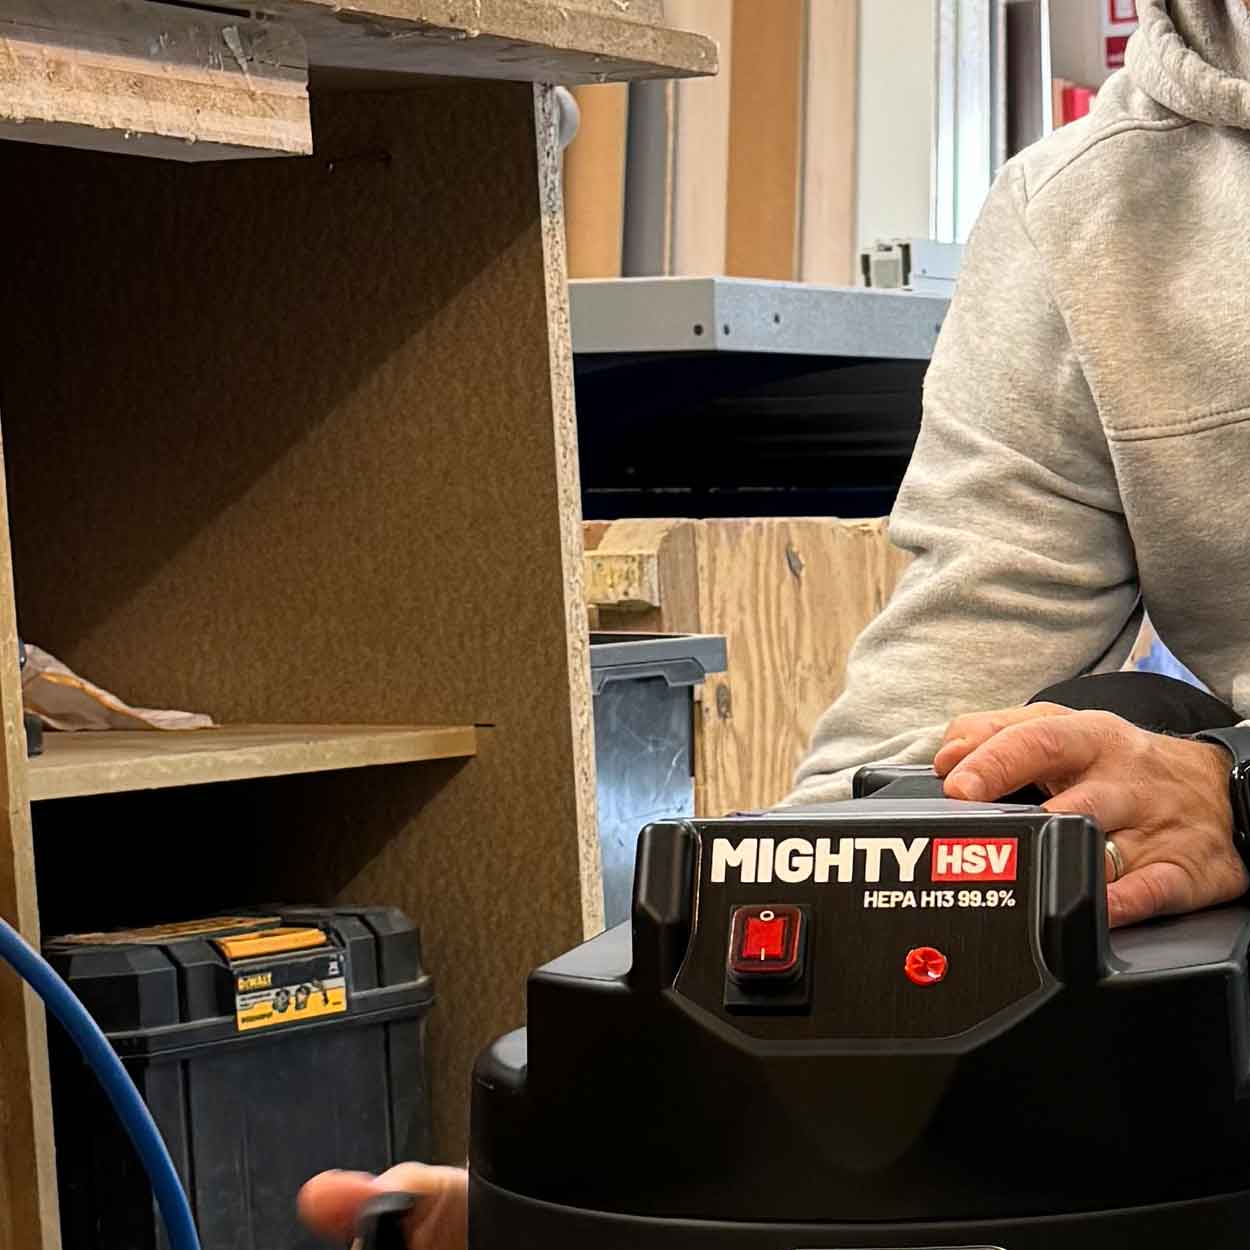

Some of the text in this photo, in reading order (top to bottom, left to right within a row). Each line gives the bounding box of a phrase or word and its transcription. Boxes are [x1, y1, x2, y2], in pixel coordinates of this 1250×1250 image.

[710, 837, 1013, 884] MIGHTY HSV
[863, 889, 1016, 909] HEPA H13 99.9%
